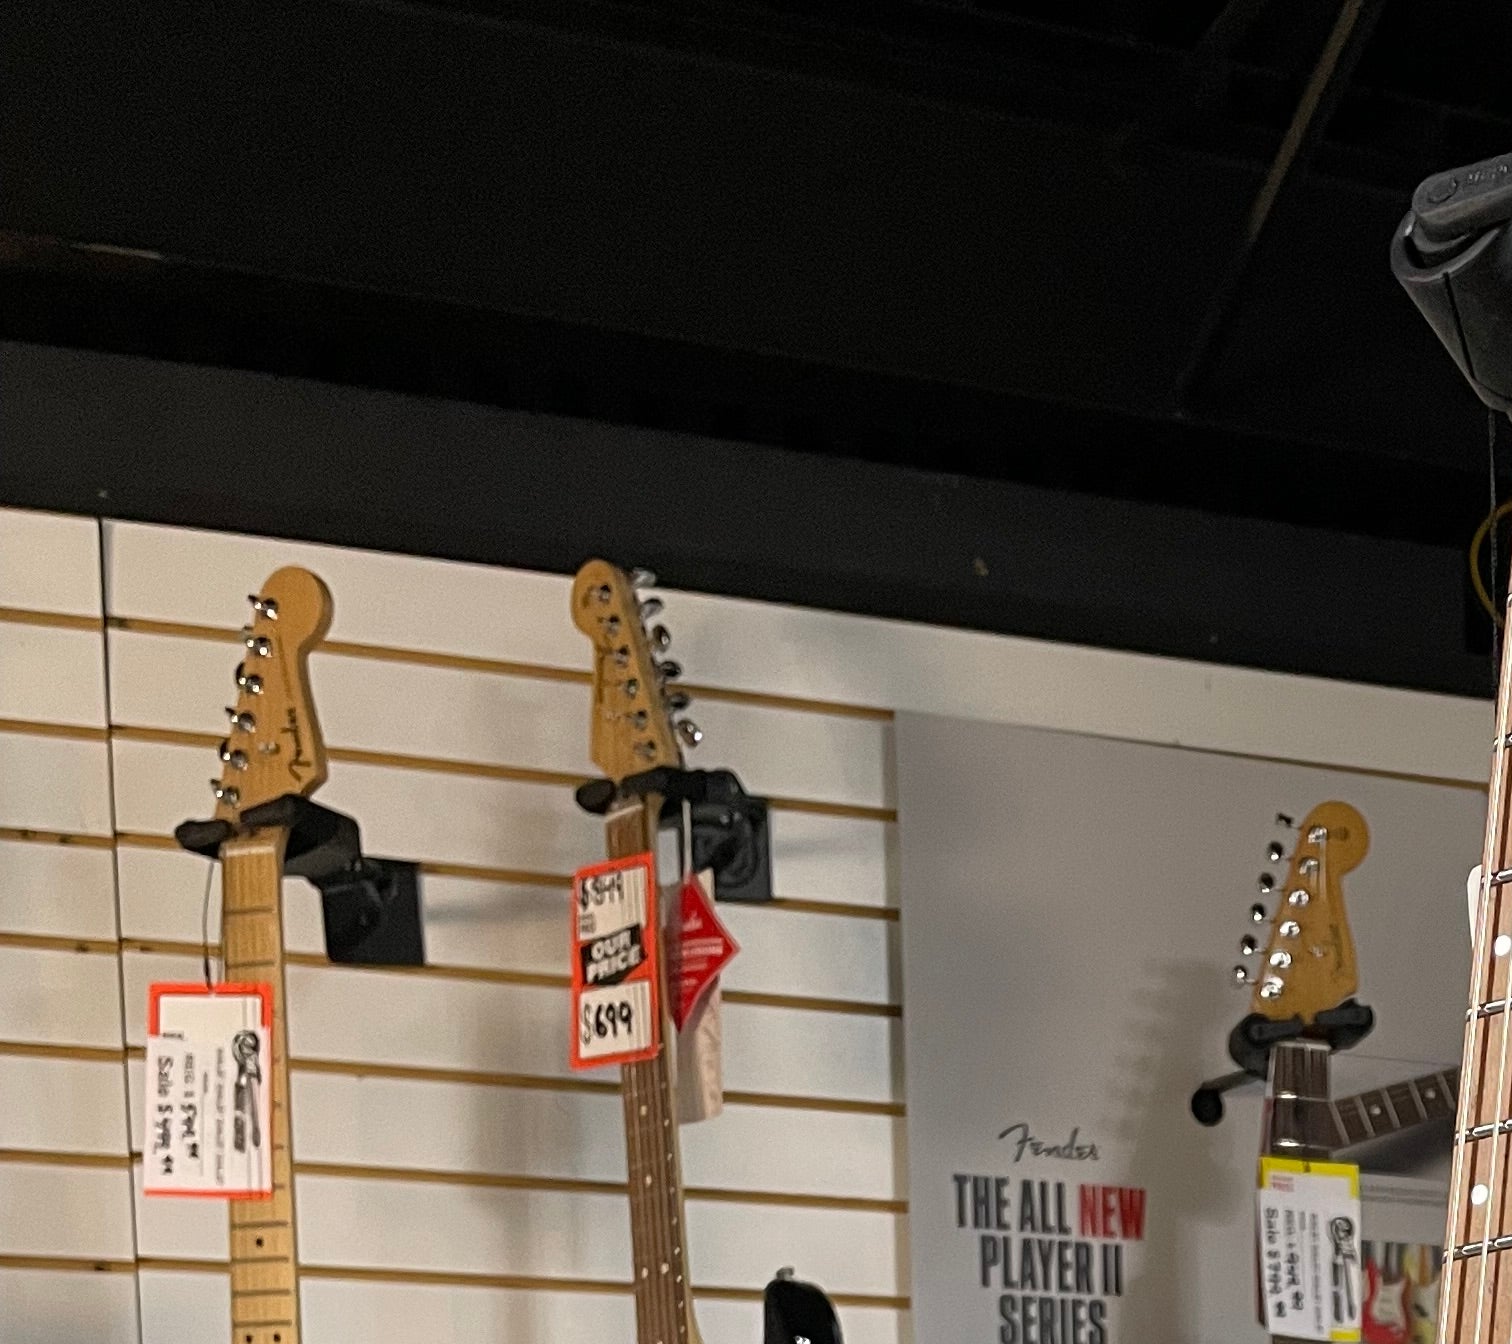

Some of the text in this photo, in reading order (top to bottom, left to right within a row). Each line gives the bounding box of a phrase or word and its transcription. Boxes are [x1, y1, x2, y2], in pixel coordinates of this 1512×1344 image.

[586, 944, 641, 984] PRICE
[591, 929, 632, 961] OUR
[583, 1001, 632, 1046] $699
[998, 1122, 1100, 1163] Fender
[953, 1173, 1146, 1240] THE ALL NEW
[980, 1235, 1123, 1297] PLAYER II
